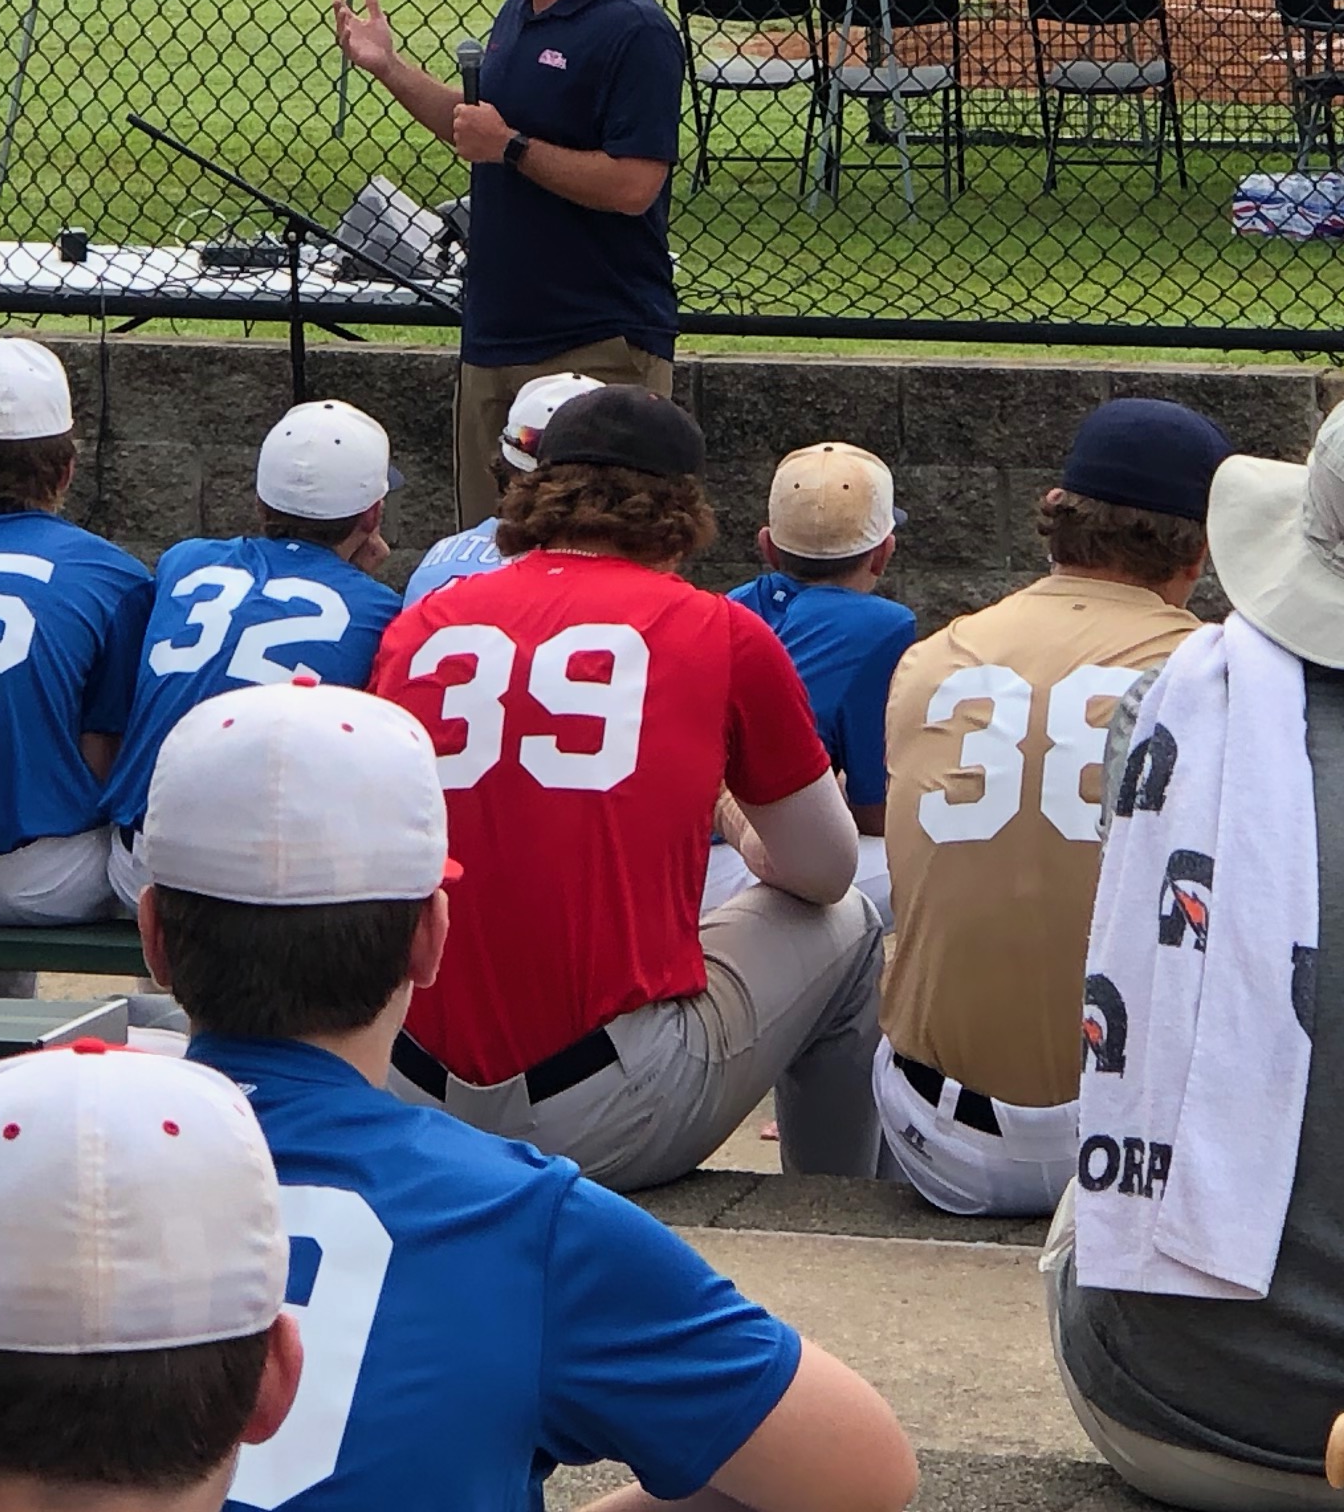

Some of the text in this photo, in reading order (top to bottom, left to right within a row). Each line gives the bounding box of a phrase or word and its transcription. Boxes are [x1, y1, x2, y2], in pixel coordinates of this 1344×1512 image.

[148, 565, 351, 686] 32
[408, 623, 650, 792] 39
[918, 663, 1146, 844] 38
